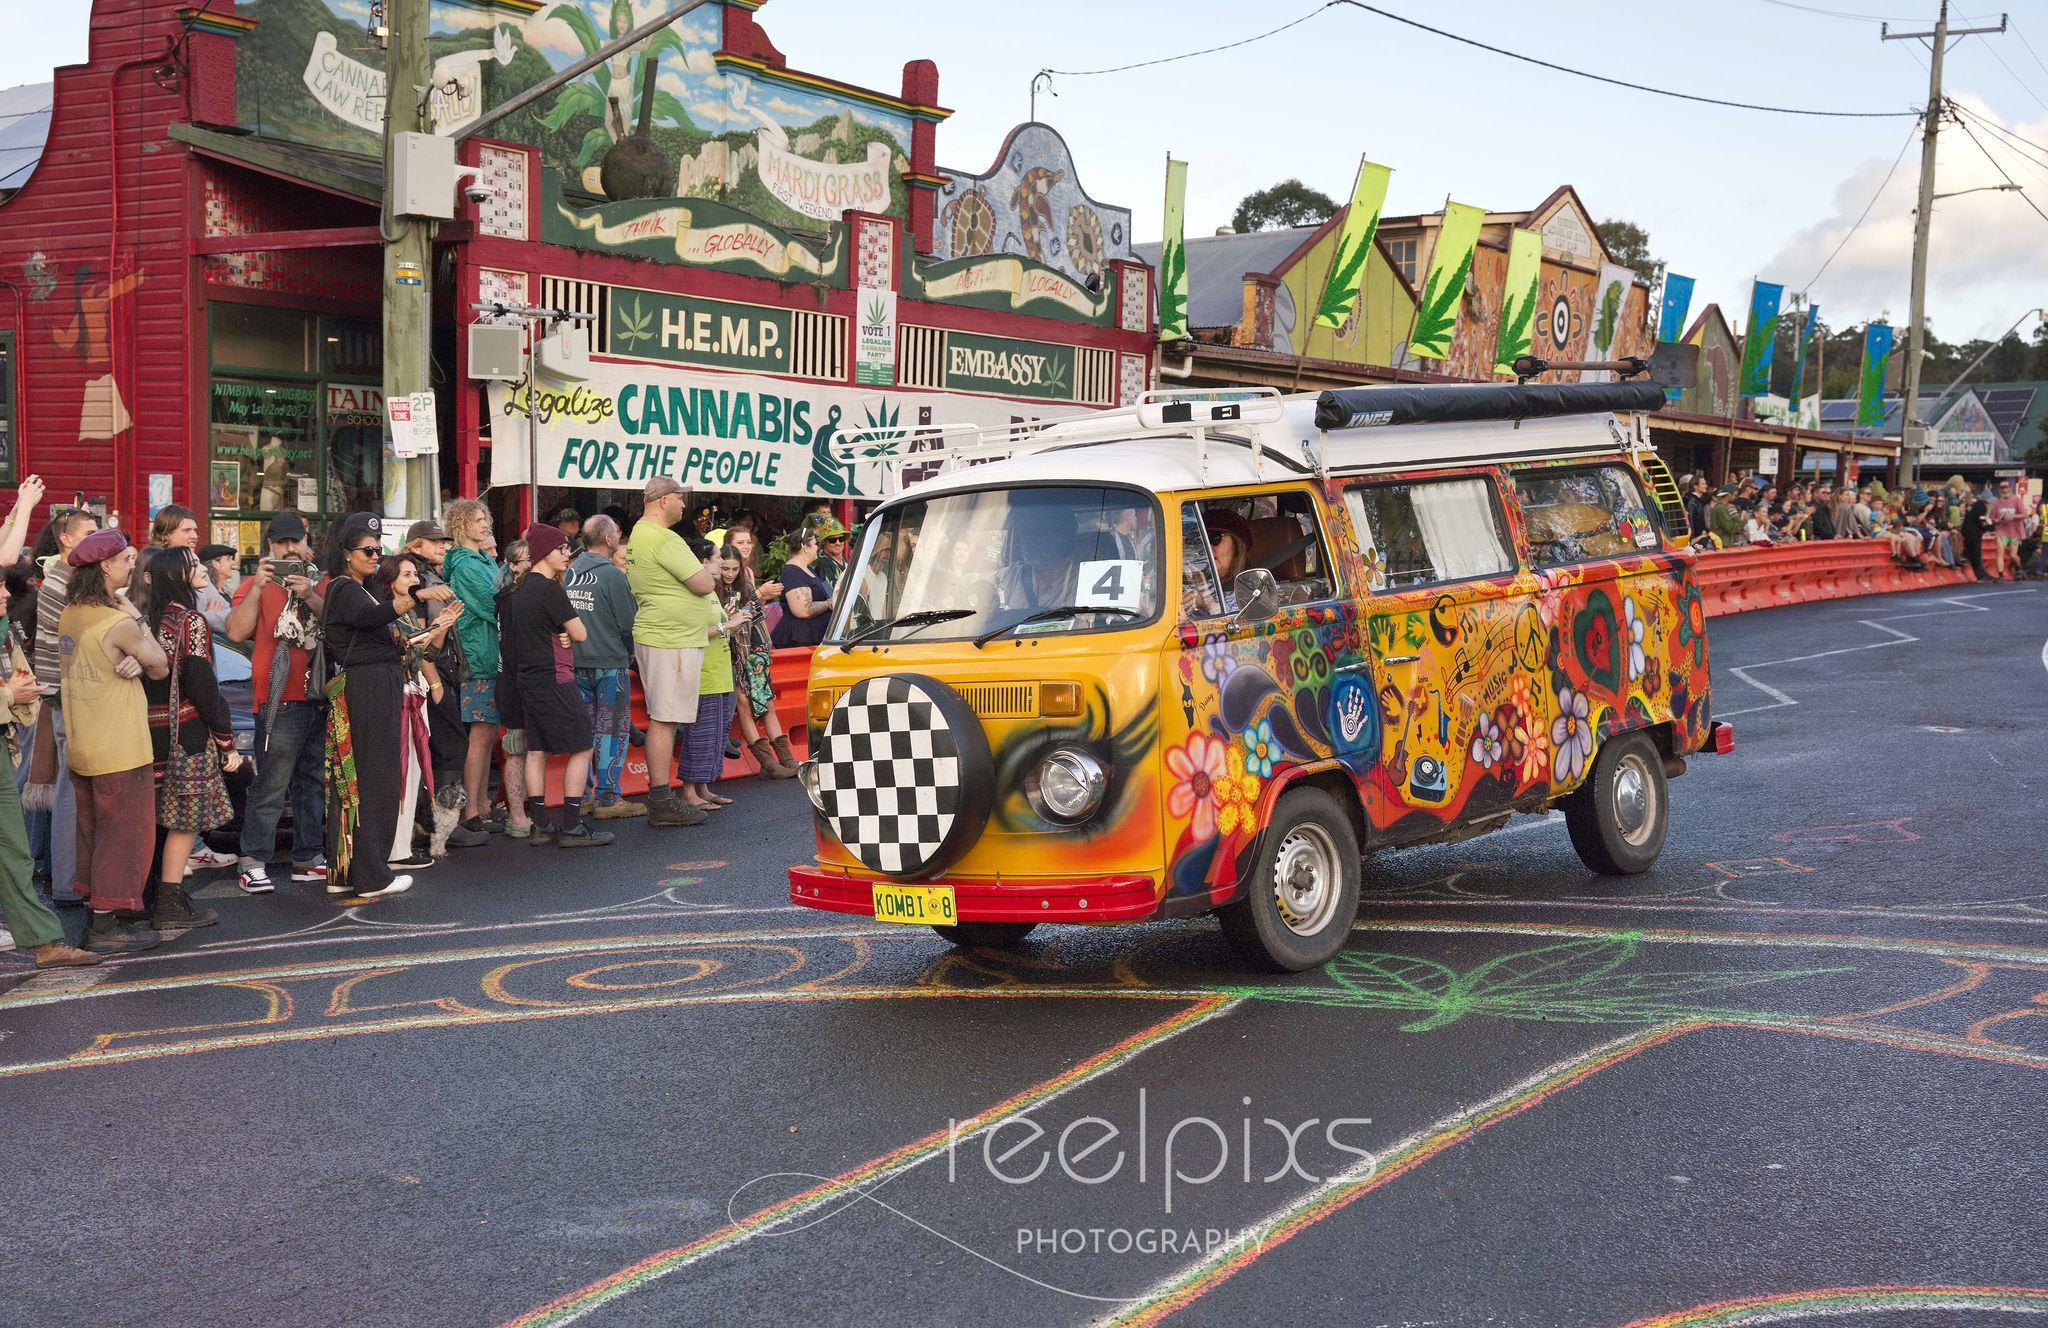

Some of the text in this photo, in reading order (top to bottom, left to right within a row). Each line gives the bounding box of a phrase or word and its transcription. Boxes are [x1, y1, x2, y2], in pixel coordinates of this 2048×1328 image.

[313, 71, 387, 124] LAW REF
[771, 181, 793, 205] FIRST
[799, 199, 833, 220] WEEKEND
[624, 216, 667, 240] THINK
[1029, 274, 1077, 301] LOCALLY
[862, 324, 884, 337] VOTE
[661, 308, 1046, 386] H.E.M.P. EMBASSY
[861, 345, 892, 353] CANNABIS
[862, 338, 891, 346] LEGALISE
[866, 351, 886, 359] PARTY
[214, 383, 253, 397] NIMBIN
[328, 387, 383, 411] TAIN
[229, 401, 249, 416] May
[412, 397, 432, 411] 2P
[504, 372, 813, 445] Legalize CANNABIS
[394, 410, 408, 420] ZONE
[1345, 410, 1394, 428] KINGS
[1924, 439, 1993, 456] UNDROMAT
[558, 437, 781, 487] FOR THE PEOPLE
[1091, 565, 1125, 601] 4
[566, 589, 595, 601] RALLEL
[570, 600, 594, 611] VERSE
[1483, 671, 1508, 704] MUSIC
[1199, 692, 1214, 711] Daisy
[627, 761, 648, 775] Coa
[875, 893, 952, 919] KOMBI 8
